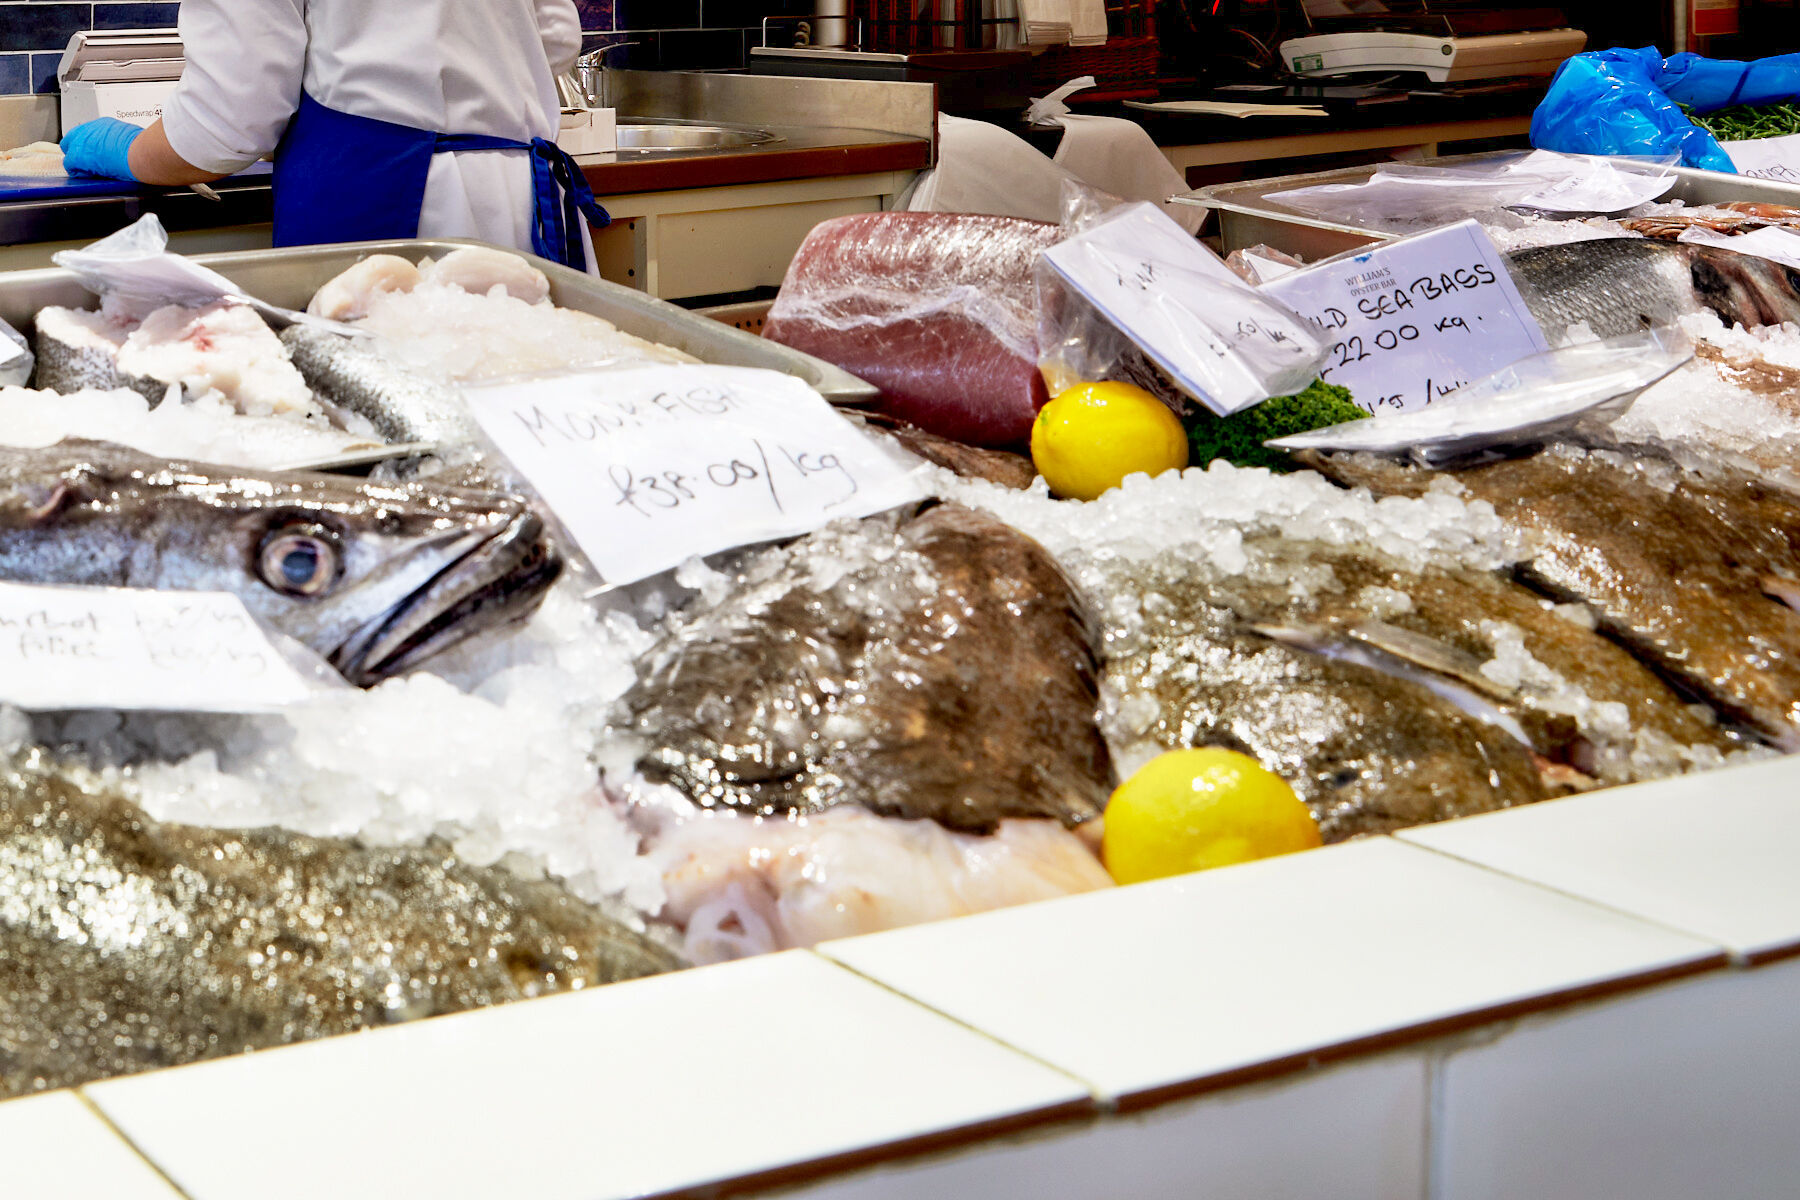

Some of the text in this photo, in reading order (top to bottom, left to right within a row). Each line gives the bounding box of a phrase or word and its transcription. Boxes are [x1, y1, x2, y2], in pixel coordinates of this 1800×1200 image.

[116, 110, 153, 119] Speedwrap
[1344, 266, 1392, 287] WILLIAM'S
[1350, 277, 1398, 297] OYSTER BAR
